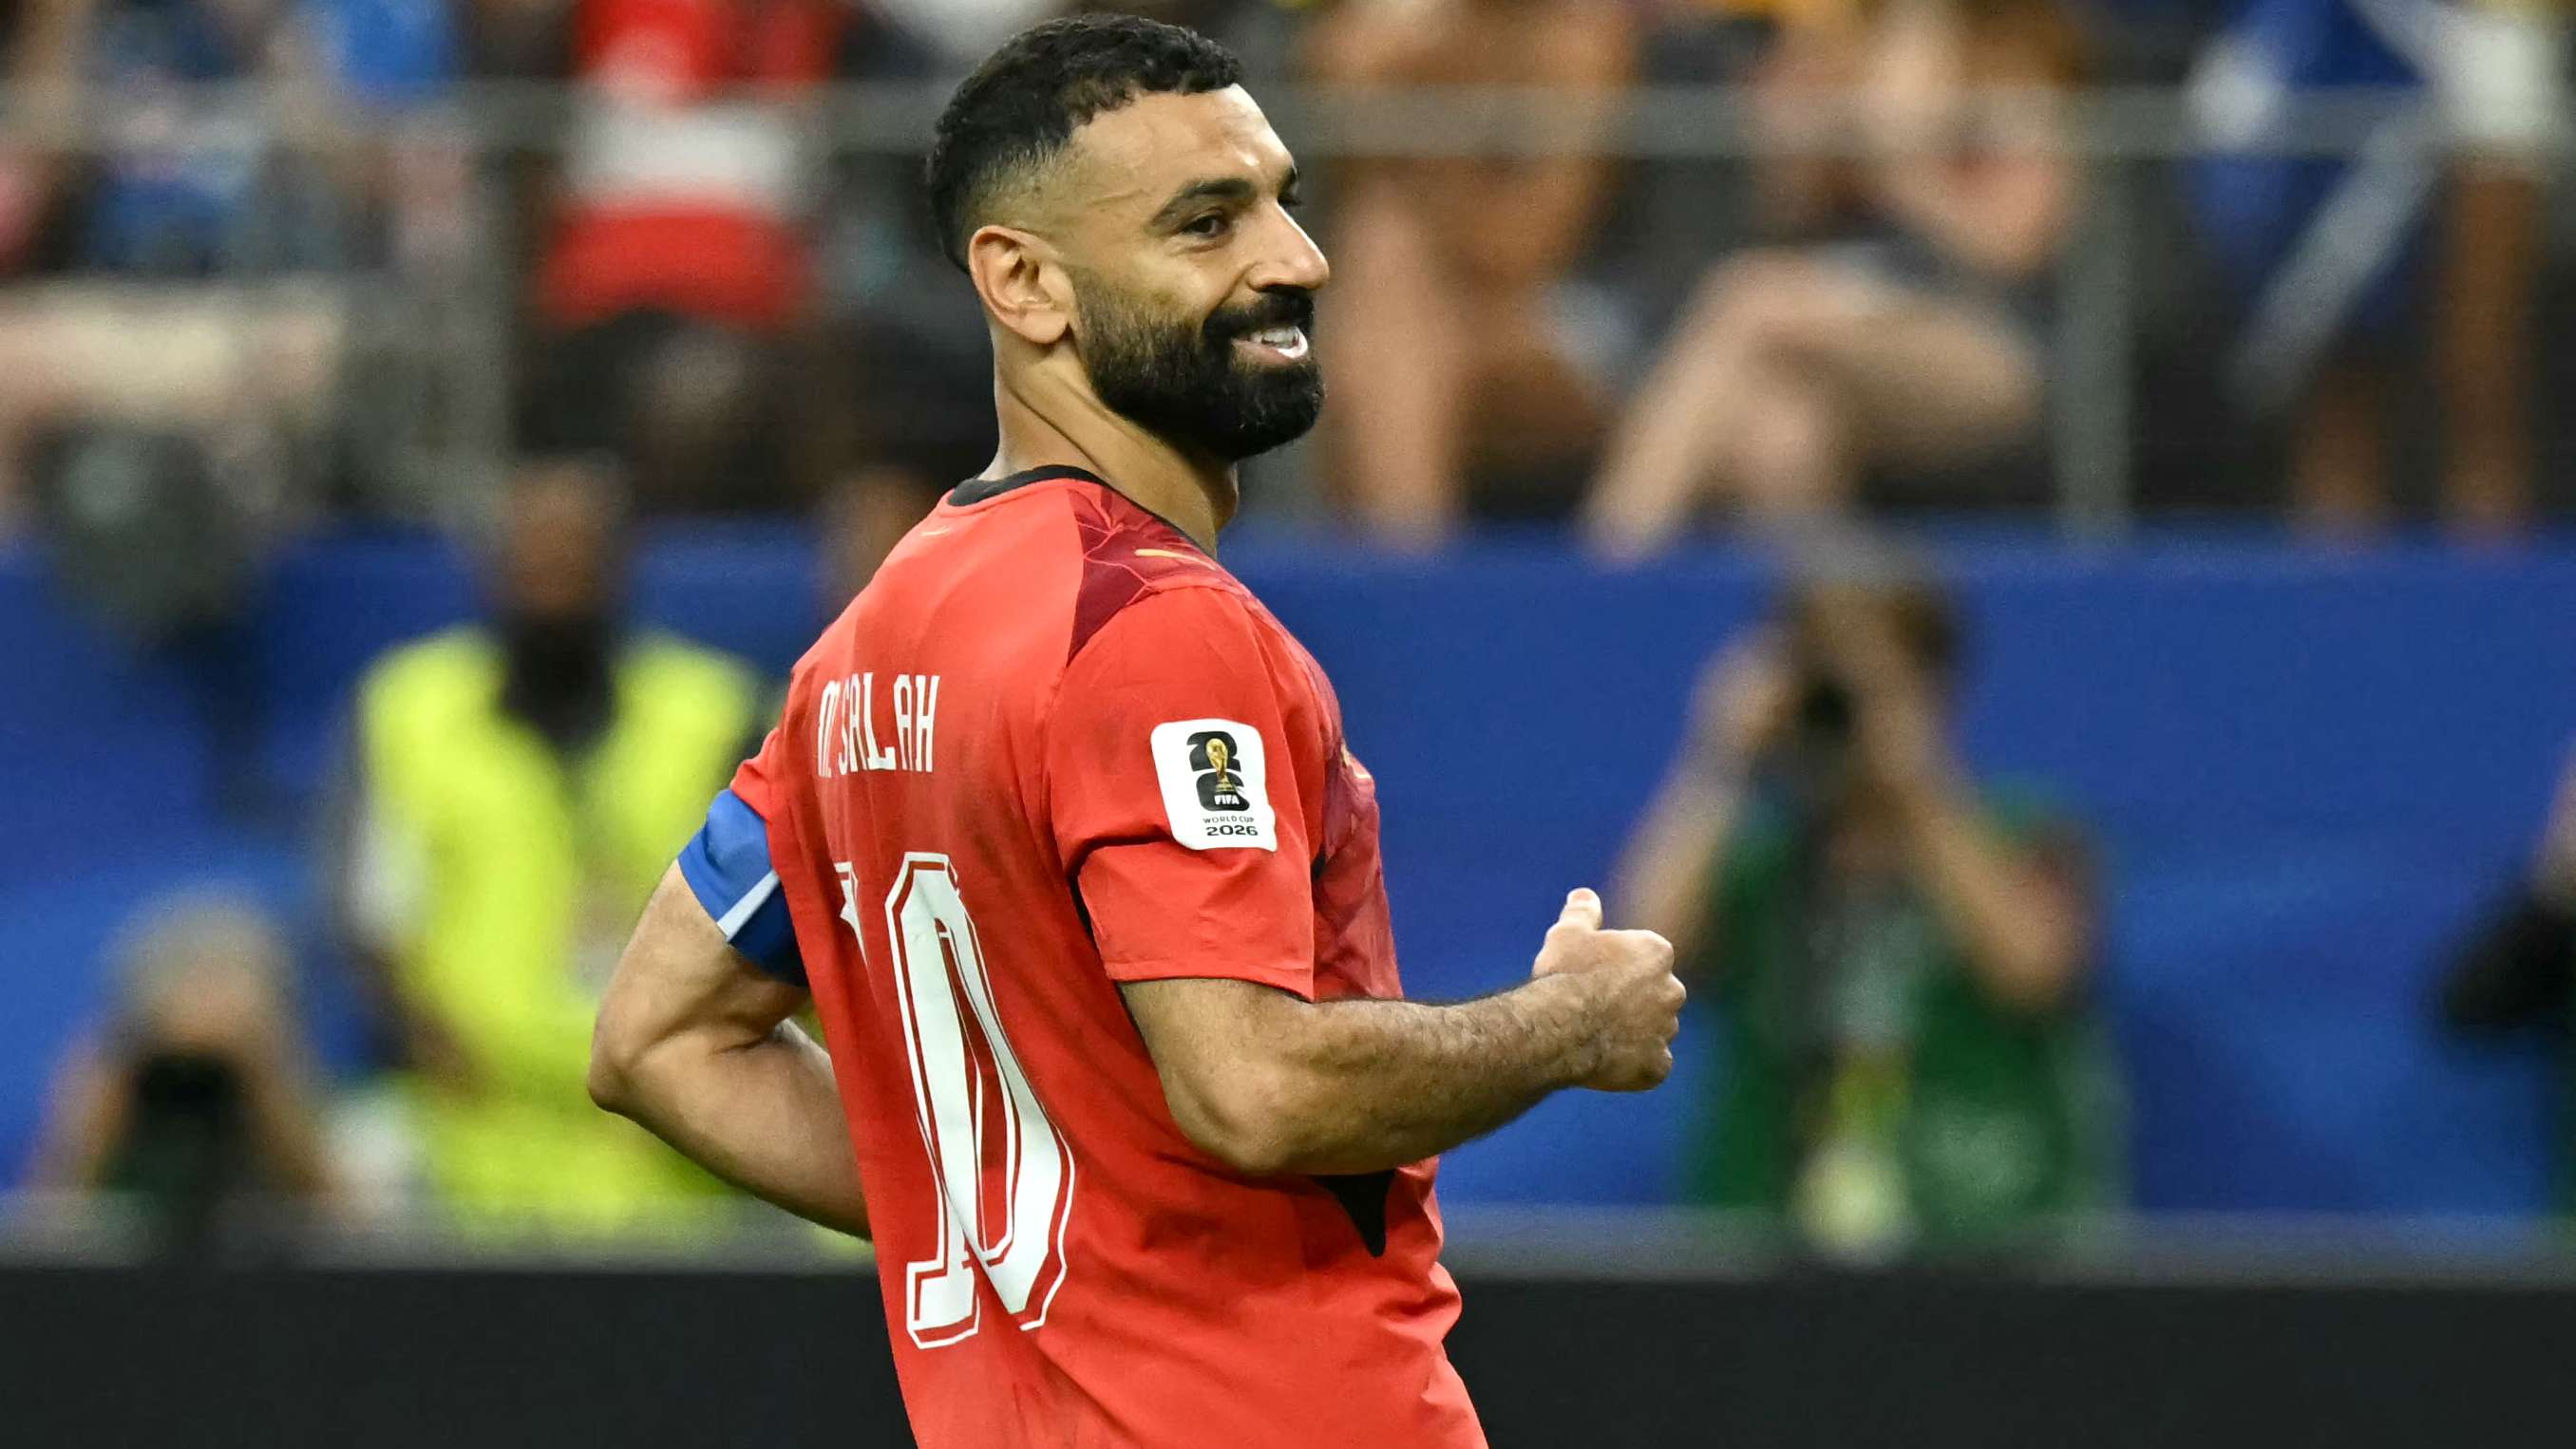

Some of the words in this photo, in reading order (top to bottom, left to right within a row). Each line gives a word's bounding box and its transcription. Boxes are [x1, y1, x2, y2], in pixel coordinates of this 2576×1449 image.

[838, 672, 941, 775] SALAH
[1214, 794, 1241, 805] FIFA
[1205, 824, 1259, 837] 2026
